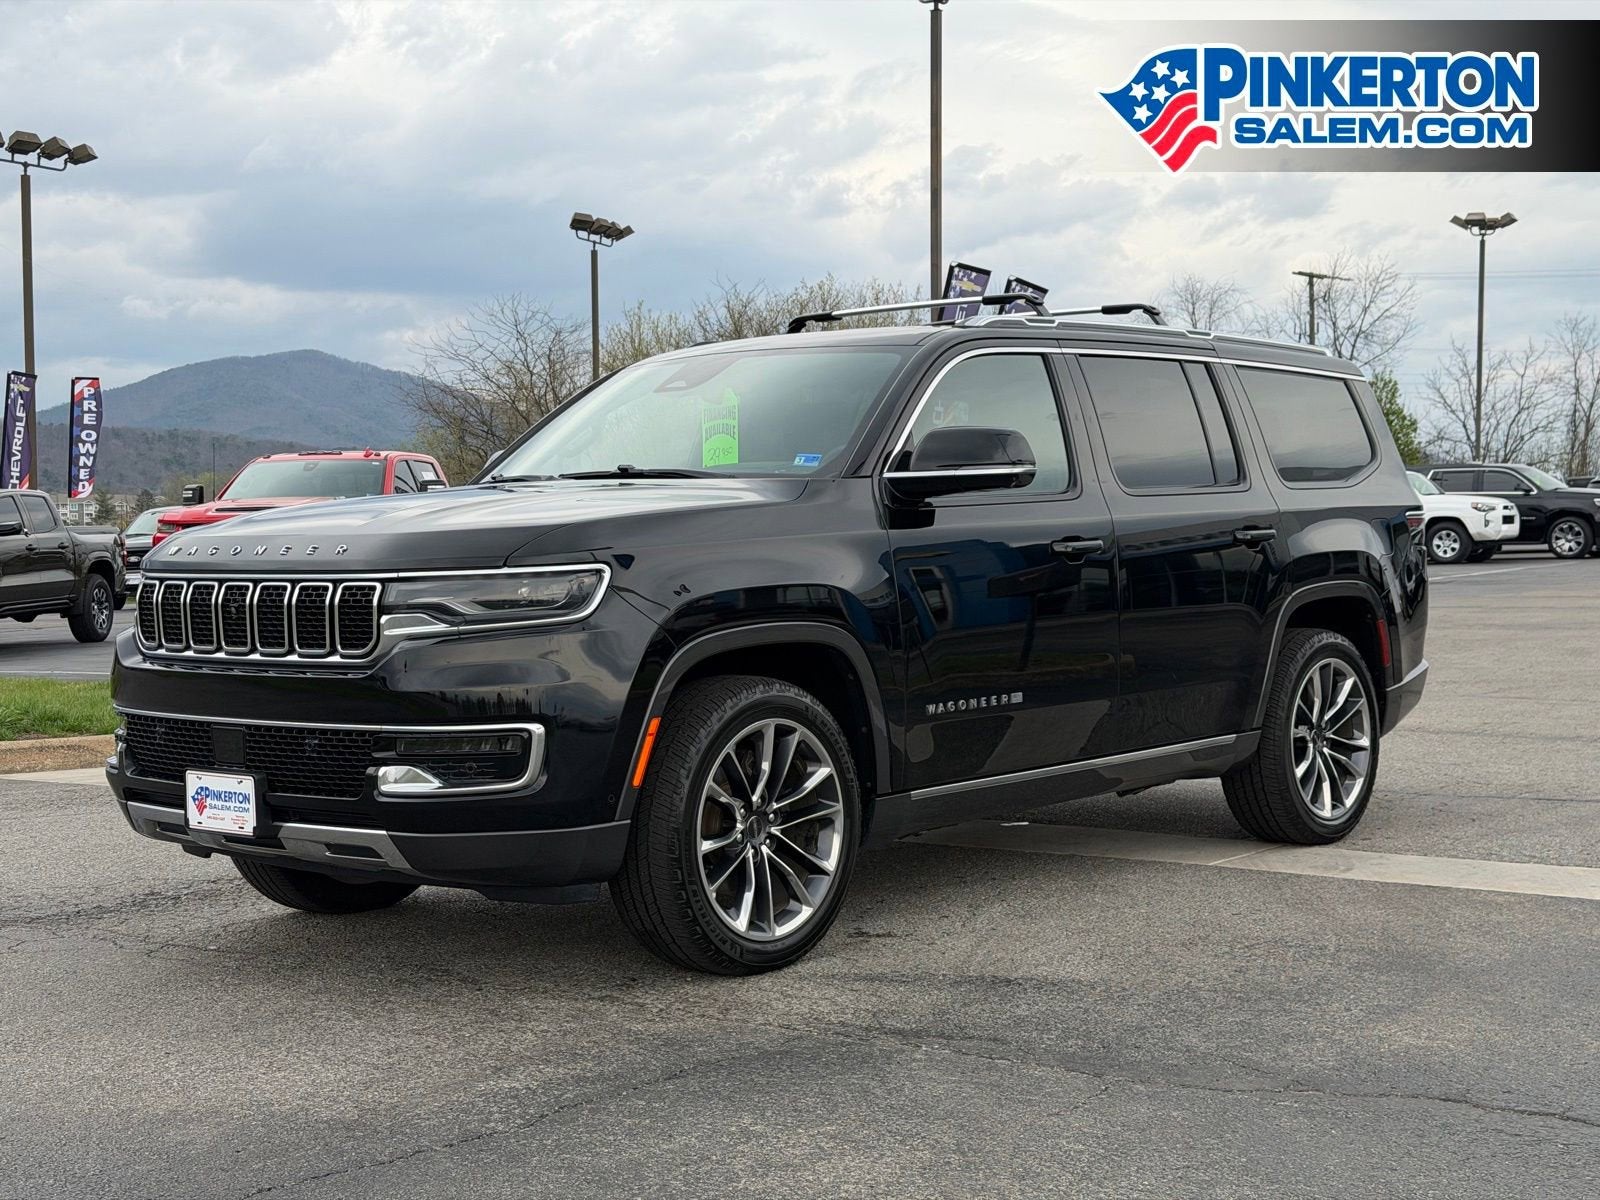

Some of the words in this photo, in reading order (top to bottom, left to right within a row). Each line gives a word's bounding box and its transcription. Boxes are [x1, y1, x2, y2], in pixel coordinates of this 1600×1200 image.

[83, 386, 97, 425] PRE
[704, 422, 737, 443] AVAILABLE
[78, 430, 97, 492] OWNED
[168, 544, 349, 556] WAGONEER
[925, 694, 1009, 715] WAGONEER
[204, 786, 251, 806] PINKERTON
[208, 803, 250, 814] SALEM.COM
